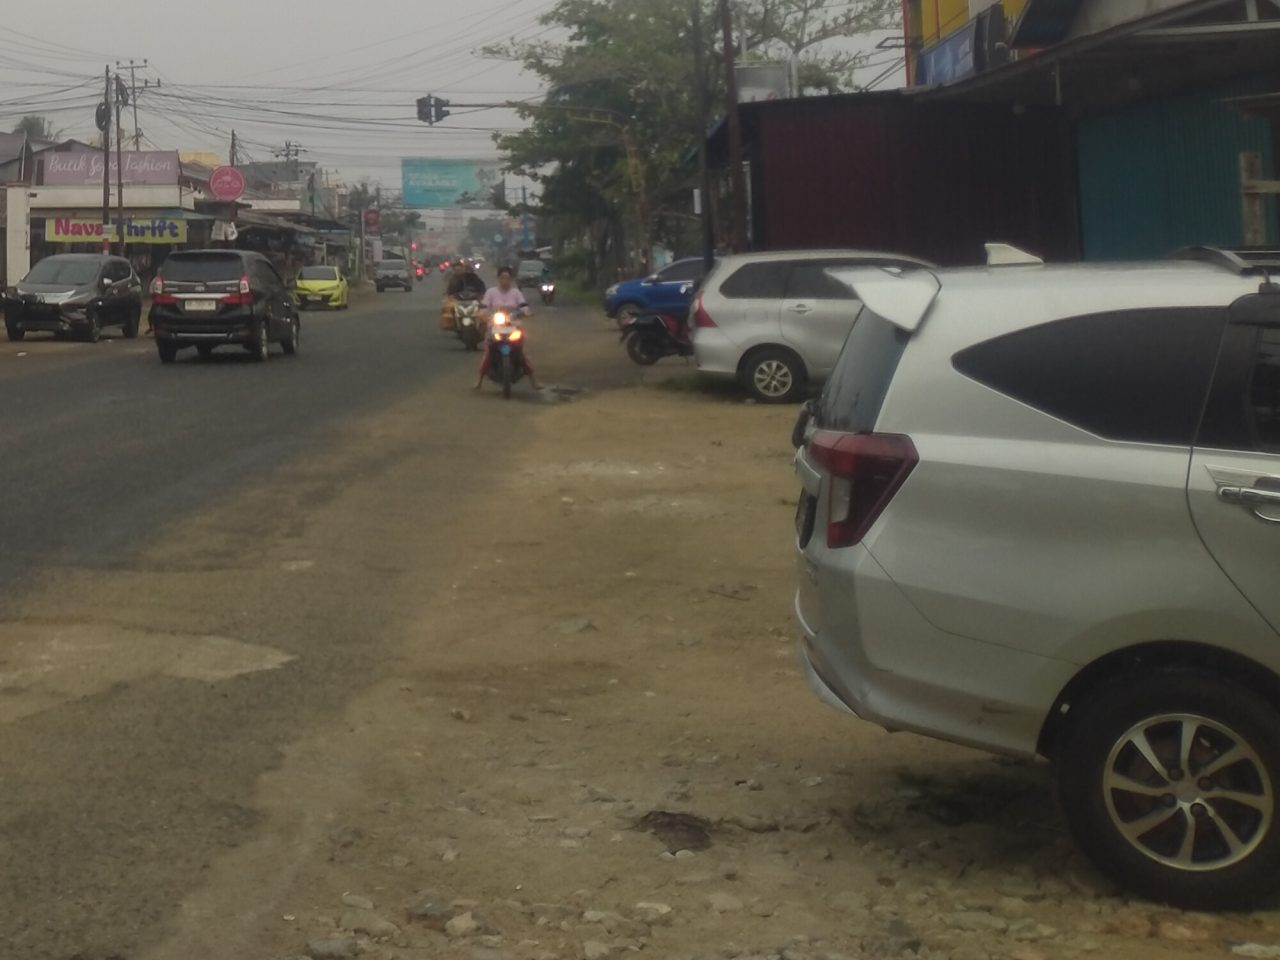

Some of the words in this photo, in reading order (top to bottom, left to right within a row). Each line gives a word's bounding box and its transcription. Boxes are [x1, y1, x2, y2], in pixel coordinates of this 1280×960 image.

[49, 154, 87, 172] Butik
[124, 154, 172, 173] Fashion
[54, 218, 105, 237] Nava
[111, 217, 180, 238] Thrift
